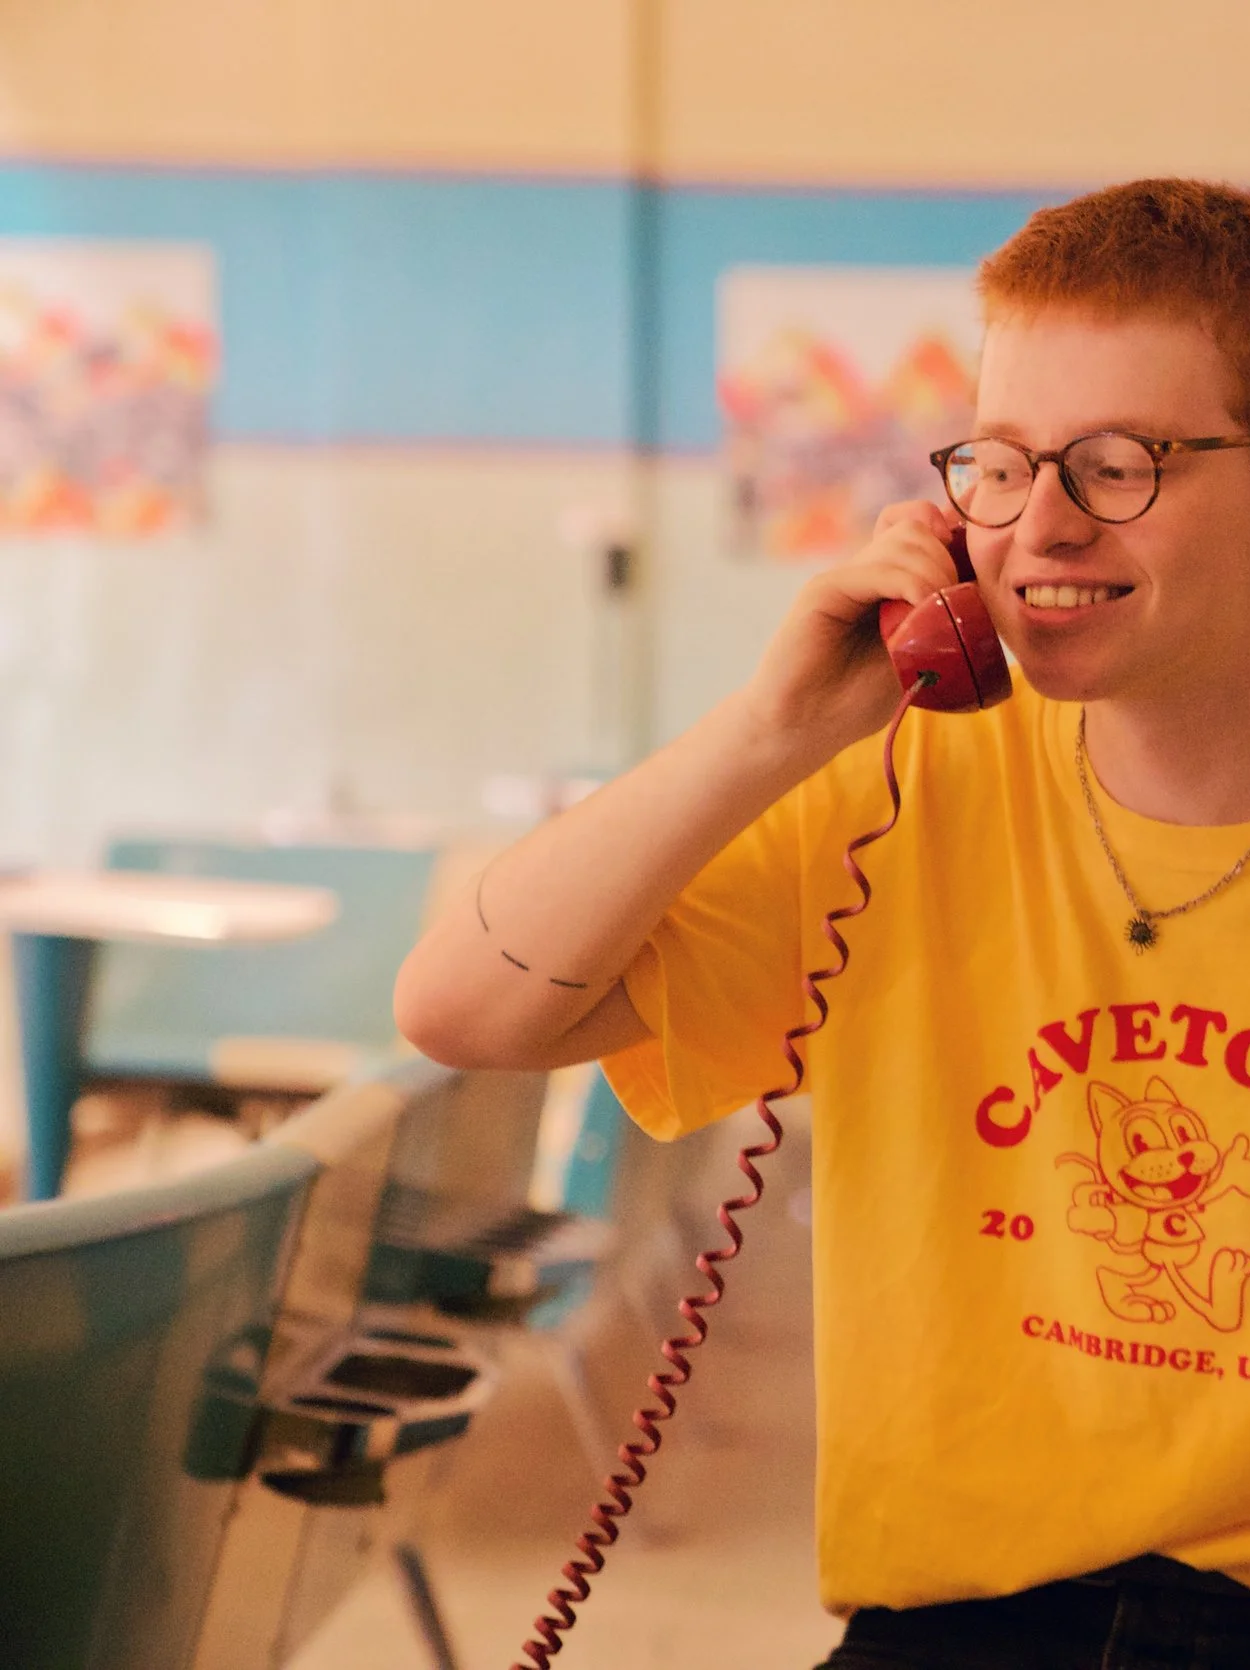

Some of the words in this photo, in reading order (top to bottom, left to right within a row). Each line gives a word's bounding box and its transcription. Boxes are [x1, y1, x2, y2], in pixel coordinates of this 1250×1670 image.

[979, 1209, 1035, 1241] 20
[1163, 1213, 1187, 1237] C
[1021, 1314, 1225, 1380] CAMBRIDGE,
